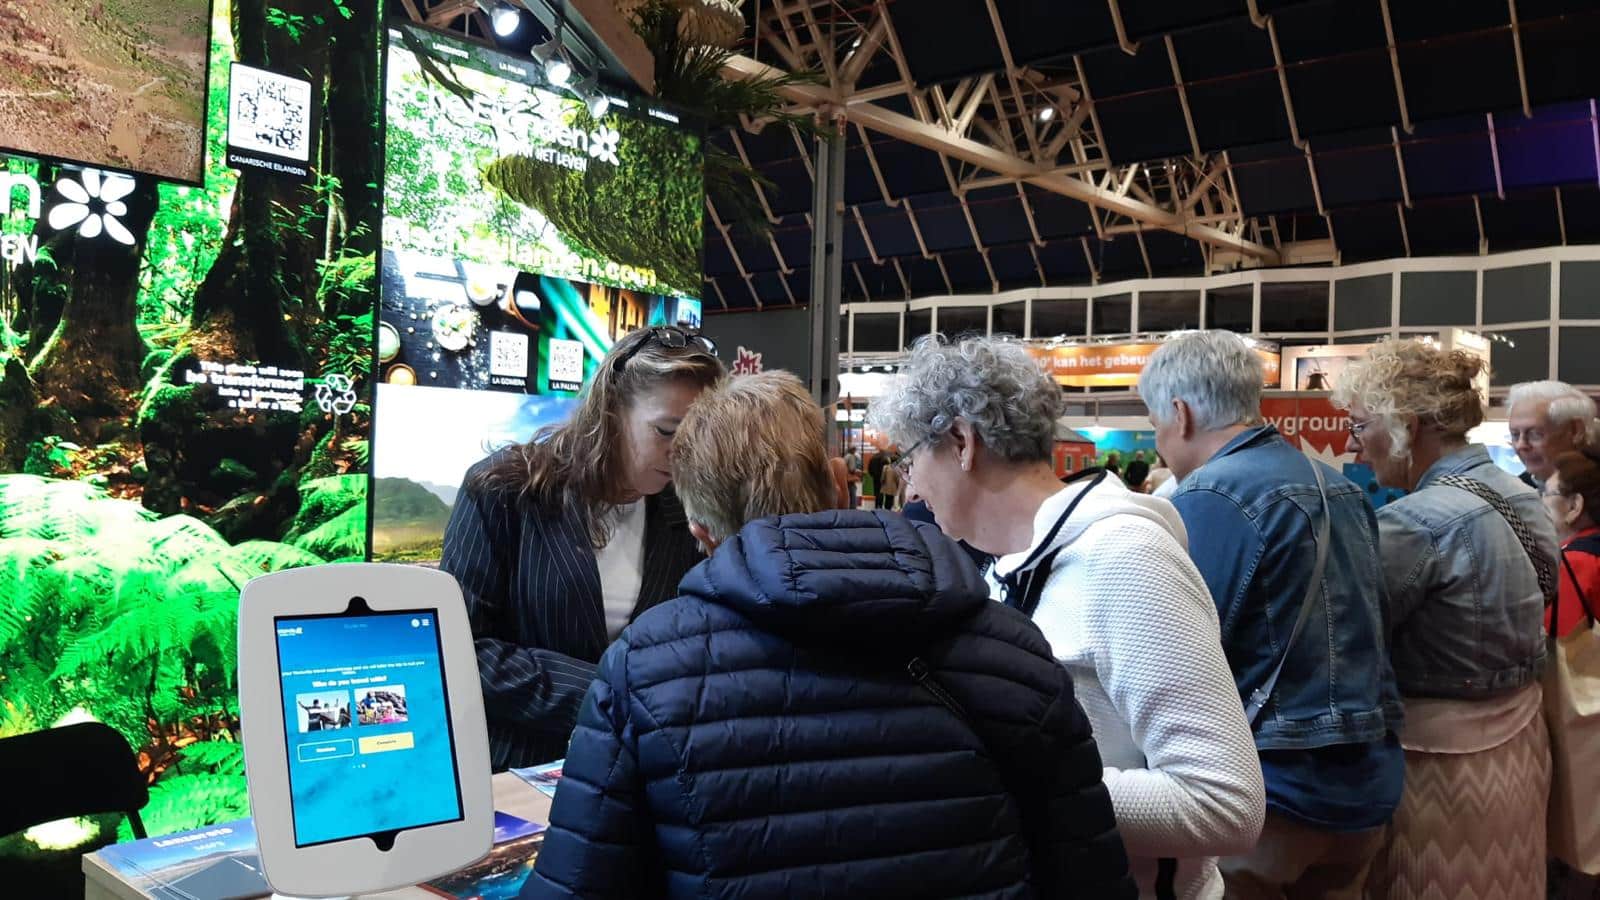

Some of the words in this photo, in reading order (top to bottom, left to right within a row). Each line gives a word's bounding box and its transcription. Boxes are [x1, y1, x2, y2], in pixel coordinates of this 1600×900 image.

[229, 154, 272, 169] CANARISCHE
[273, 163, 307, 176] EILANDEN
[1053, 354, 1077, 368] kan
[1080, 353, 1102, 368] het
[186, 369, 207, 383] be
[210, 372, 304, 390] transformed
[492, 377, 500, 385] LA
